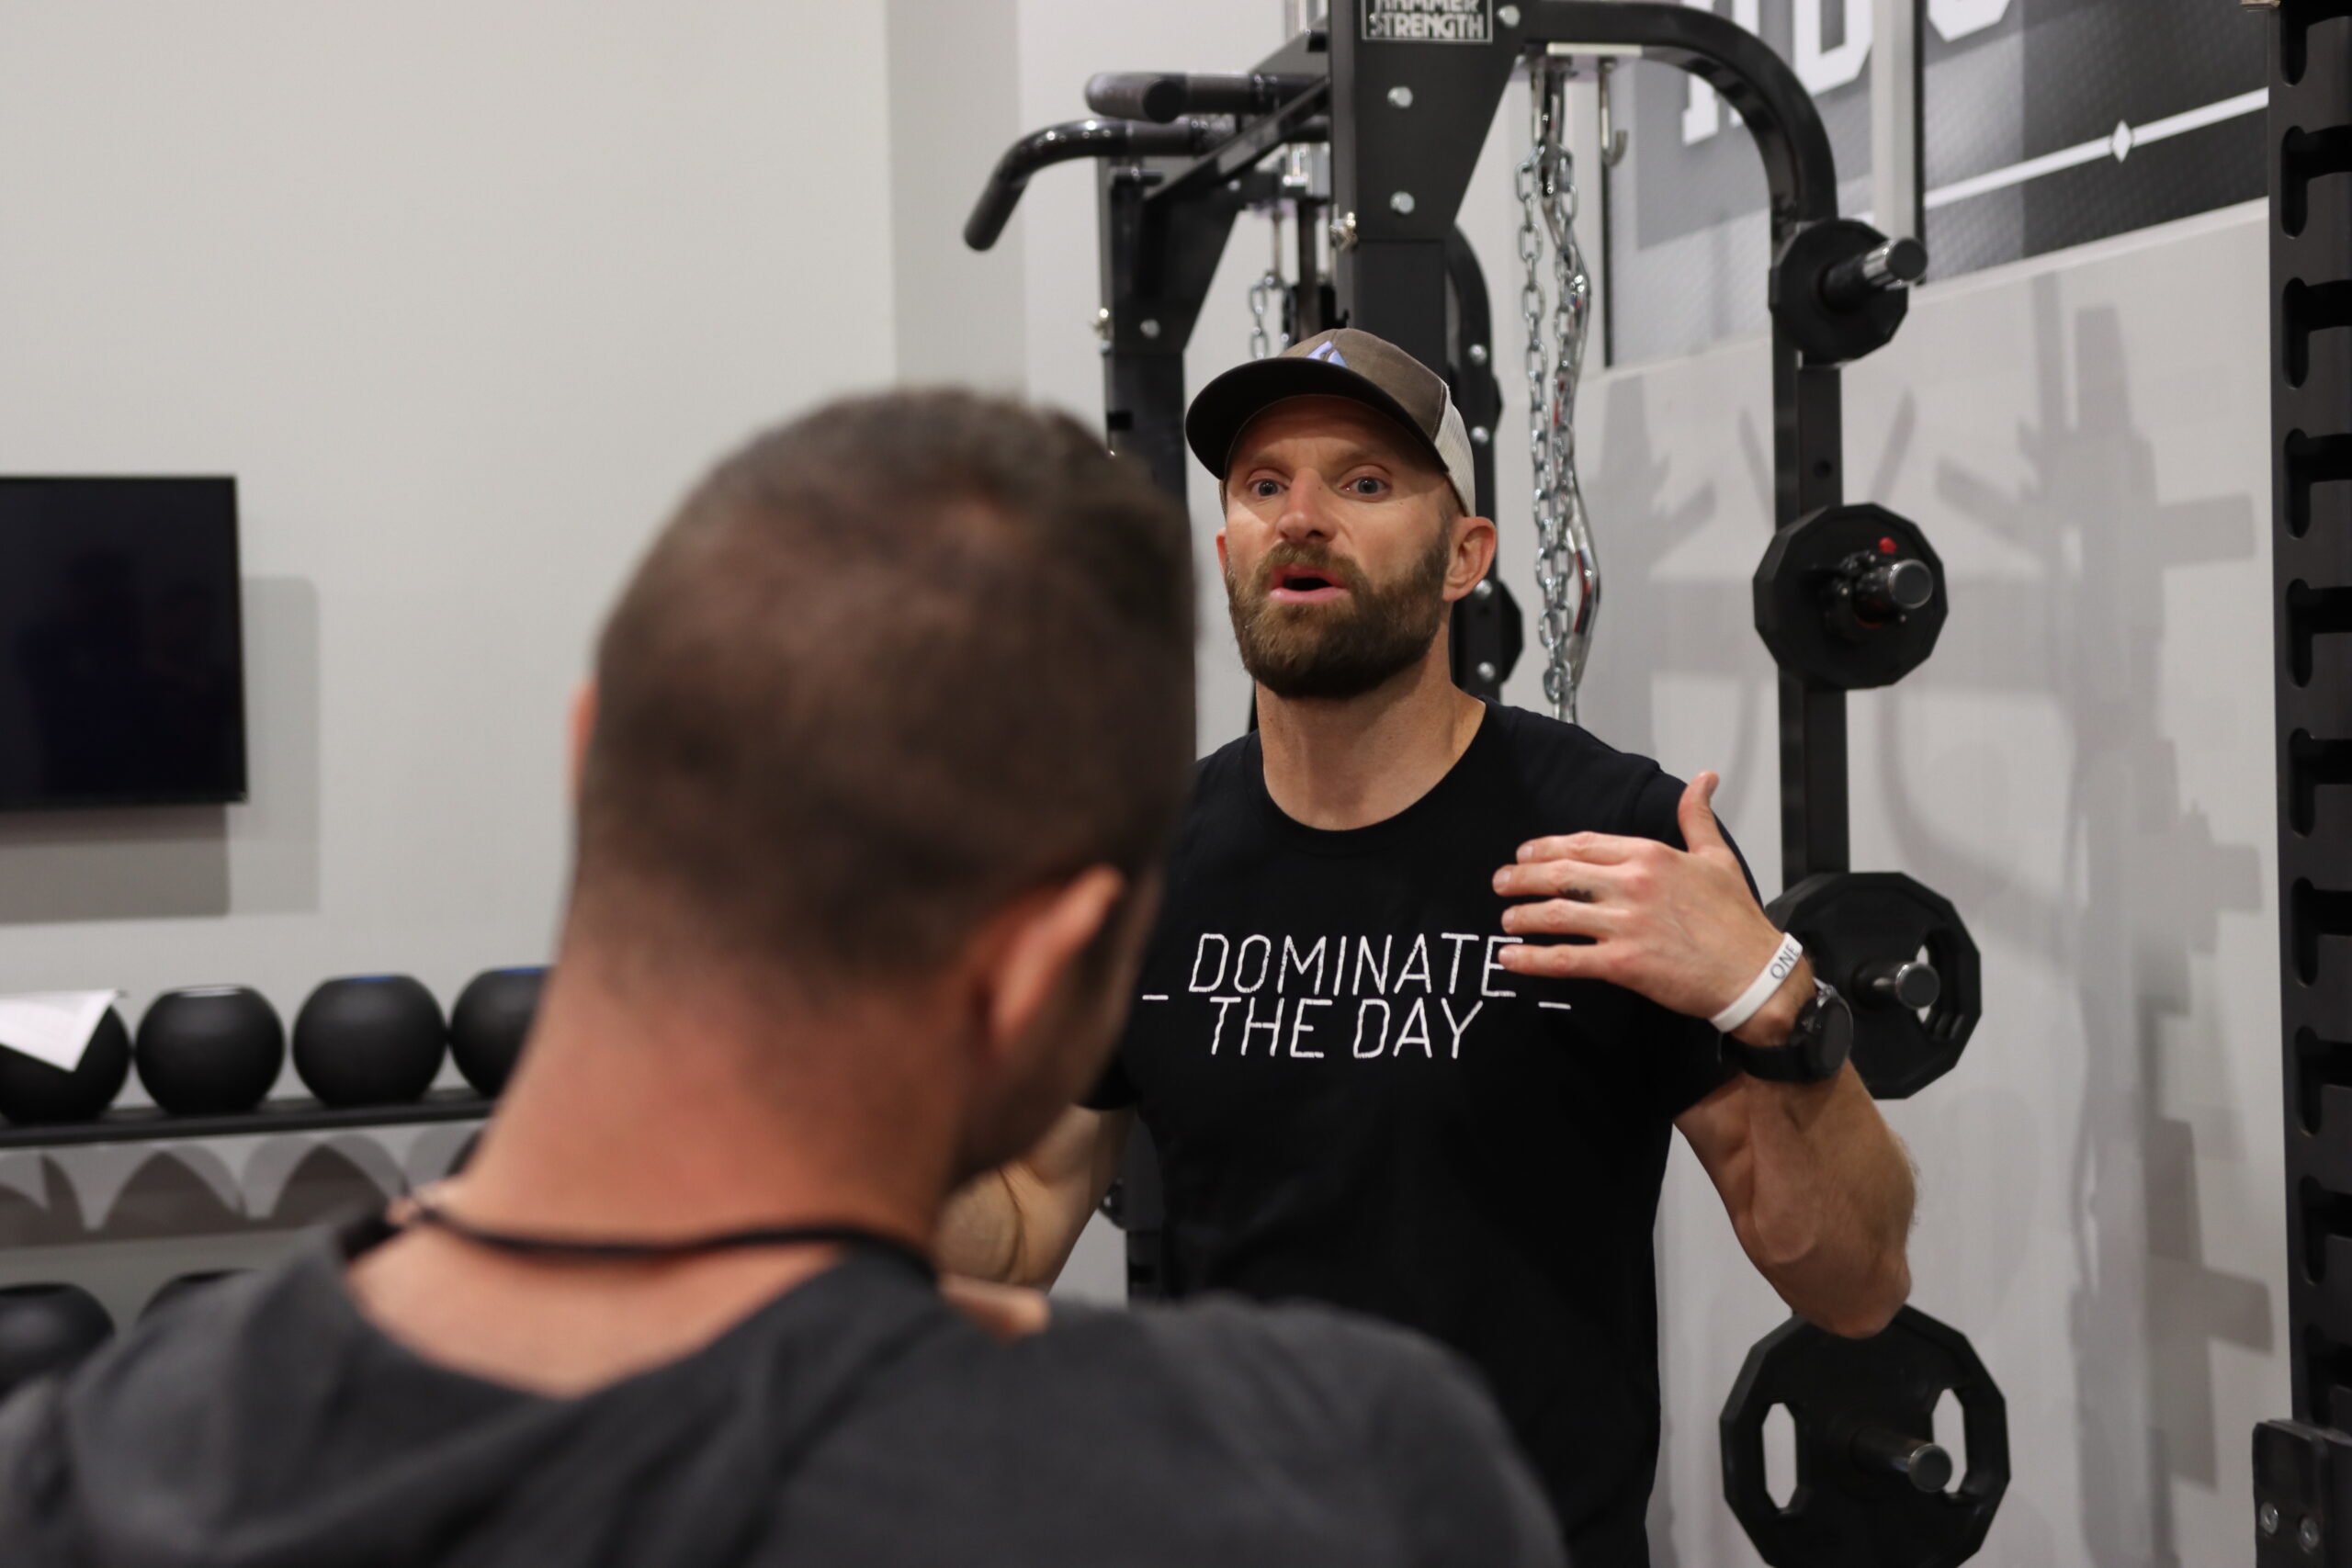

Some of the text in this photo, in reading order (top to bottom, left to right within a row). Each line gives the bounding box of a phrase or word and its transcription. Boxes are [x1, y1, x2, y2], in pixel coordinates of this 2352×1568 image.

[1369, 13, 1485, 39] STRENGTH
[1189, 933, 1523, 998] DOMINATE
[1770, 943, 1800, 979] ONE
[1209, 997, 1484, 1059] THE DAY
